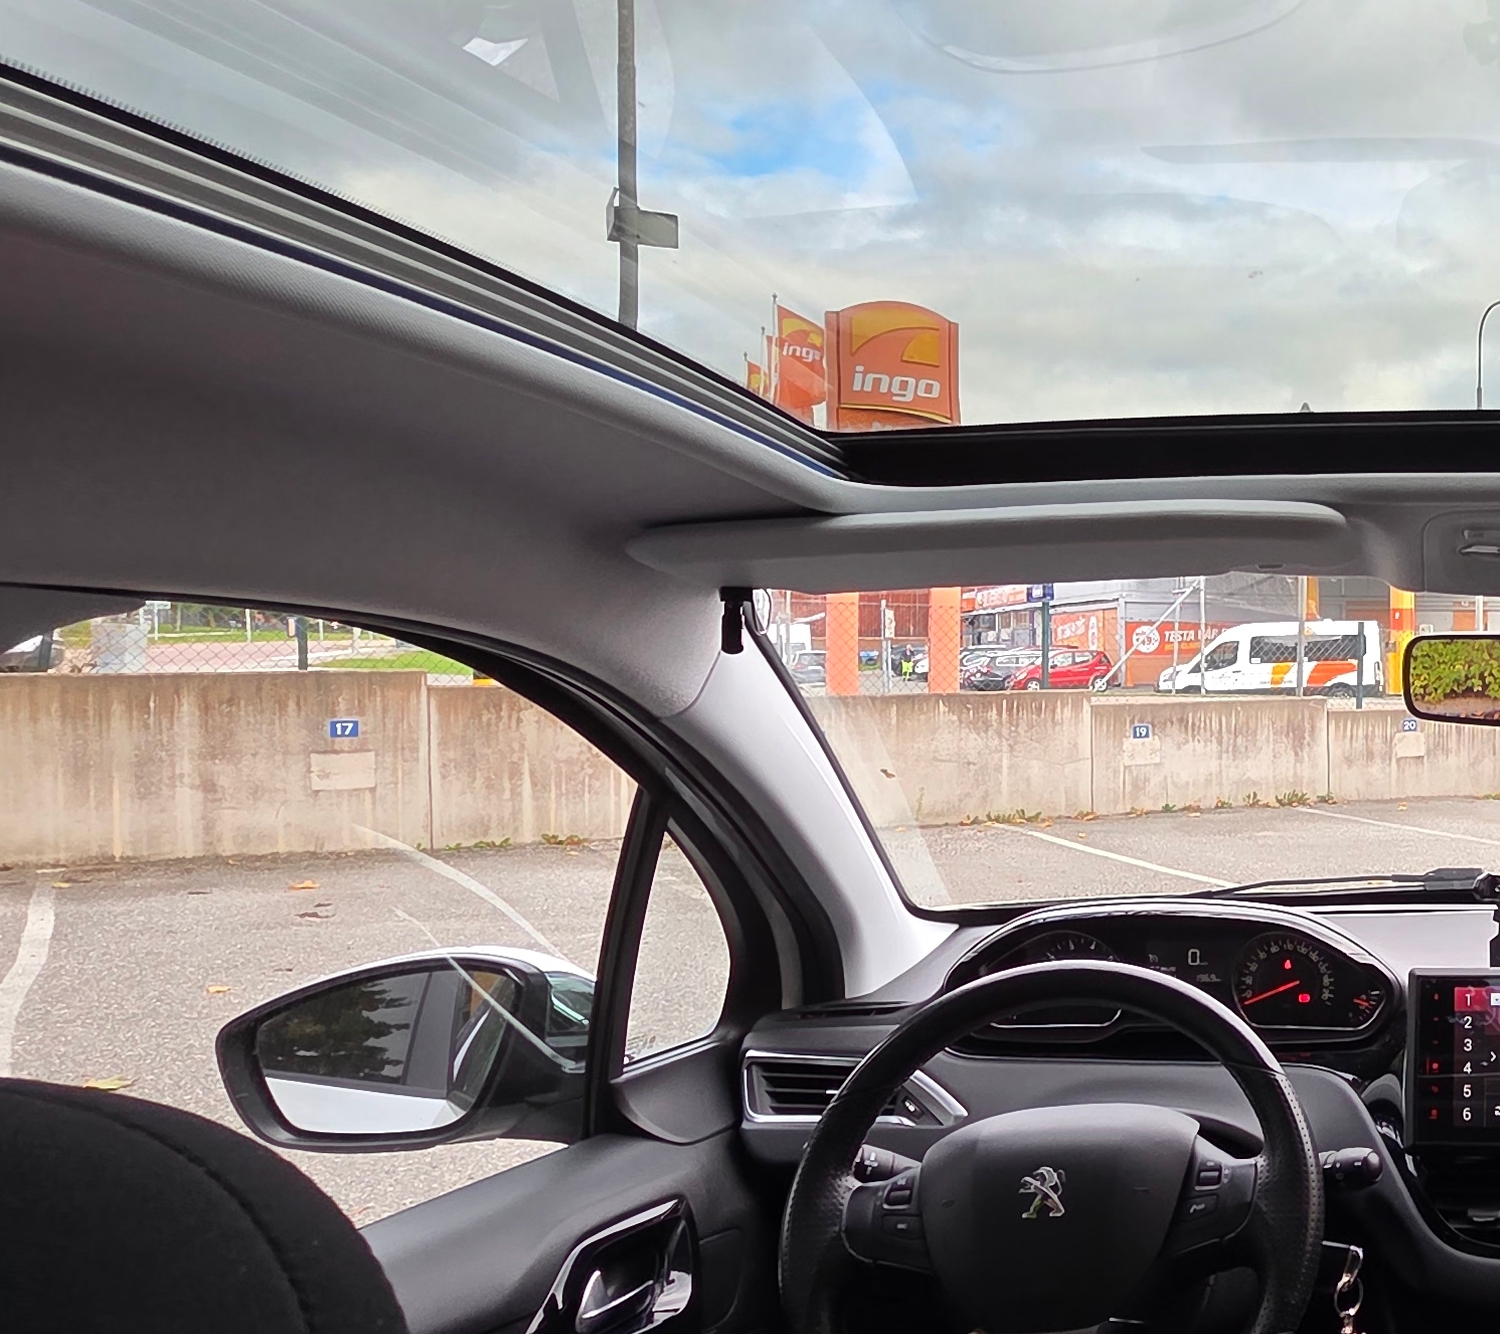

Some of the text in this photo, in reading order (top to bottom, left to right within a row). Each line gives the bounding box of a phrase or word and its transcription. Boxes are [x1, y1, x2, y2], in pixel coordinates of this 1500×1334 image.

[853, 365, 940, 402] ingo
[335, 722, 354, 736] 17
[1135, 726, 1148, 738] 19
[1403, 720, 1417, 731] 20
[1188, 948, 1200, 966] 0
[1465, 993, 1471, 1006] 1
[1463, 1016, 1473, 1028] 2
[1463, 1038, 1473, 1051] 3
[1463, 1061, 1472, 1074] 4
[1463, 1084, 1472, 1098] 5
[1462, 1107, 1472, 1121] 6
